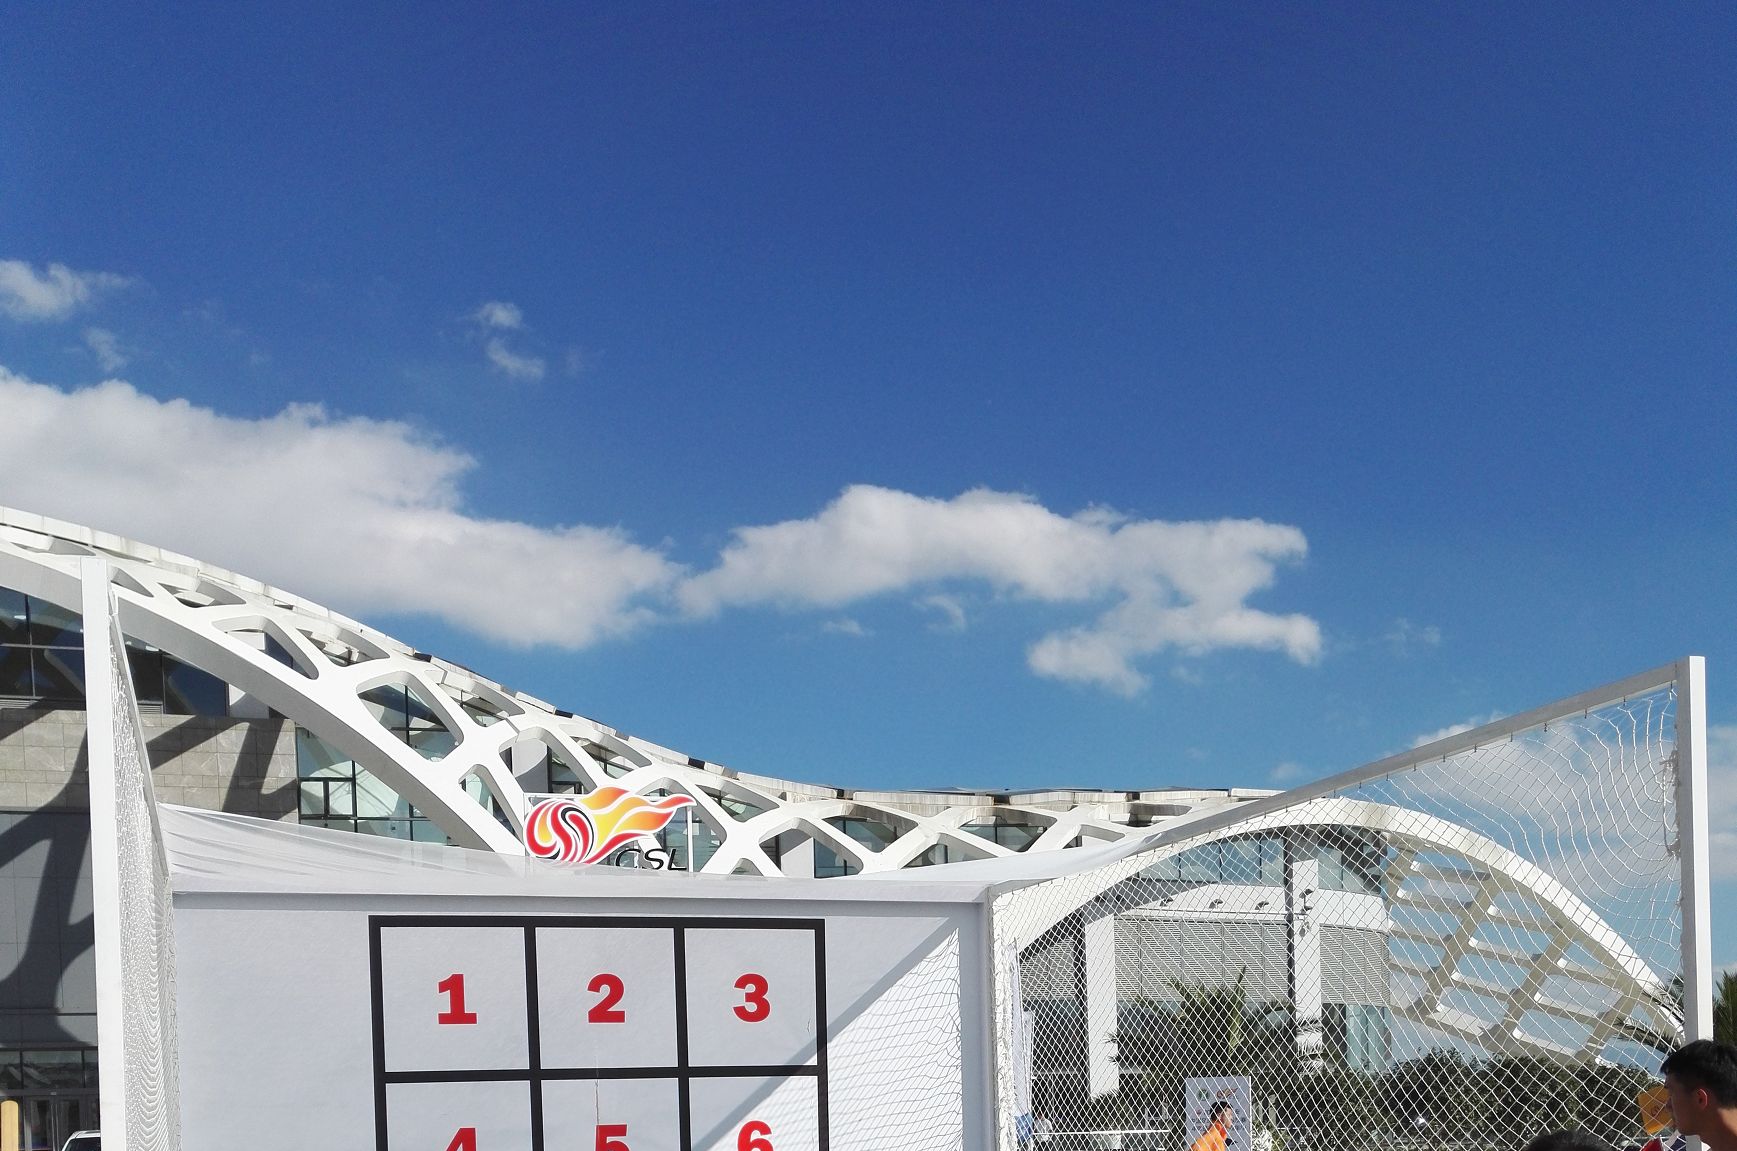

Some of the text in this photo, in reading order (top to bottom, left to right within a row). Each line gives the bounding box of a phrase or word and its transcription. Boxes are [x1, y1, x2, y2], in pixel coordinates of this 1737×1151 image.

[615, 848, 688, 871] CSL
[436, 973, 771, 1025] 1 2 3
